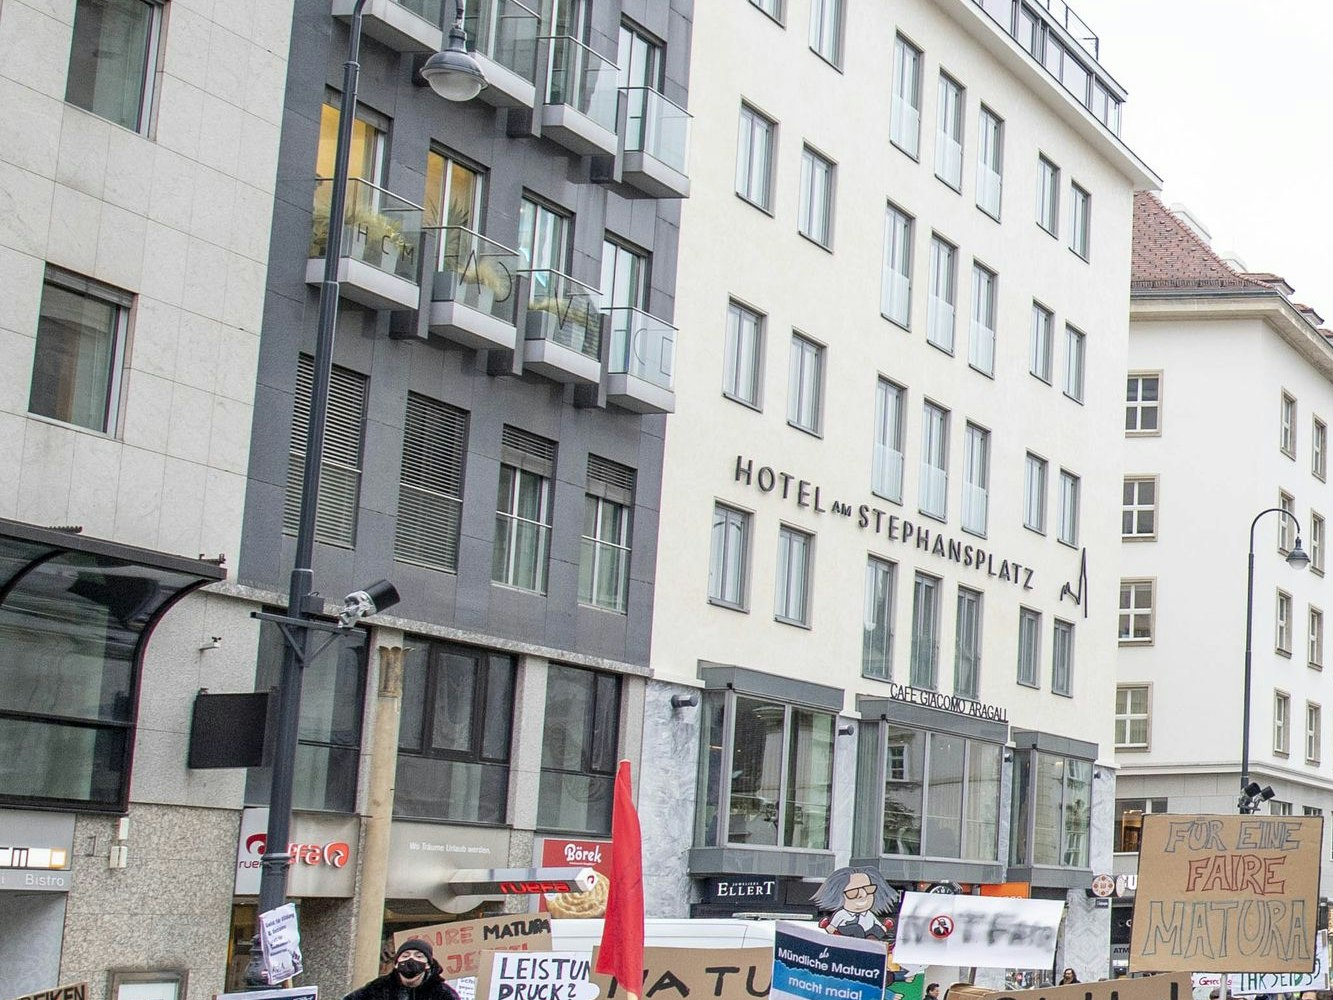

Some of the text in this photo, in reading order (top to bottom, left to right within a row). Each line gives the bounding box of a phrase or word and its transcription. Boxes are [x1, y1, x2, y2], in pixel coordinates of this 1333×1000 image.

[735, 456, 1034, 590] HOTEL AM STEPHANSPLATZ
[920, 690, 965, 714] GIACOMO
[1164, 819, 1303, 853] FÜR EINE
[446, 844, 466, 852] Urlaub
[564, 844, 602, 863] Börek
[26, 875, 65, 887] Bistro
[1186, 855, 1287, 895] FAIRE
[717, 882, 775, 897] ELLERT
[483, 918, 551, 941] MATURA
[1142, 900, 1312, 961] MATURA
[778, 948, 880, 980] Mündliche Matura?
[788, 974, 823, 996] macht
